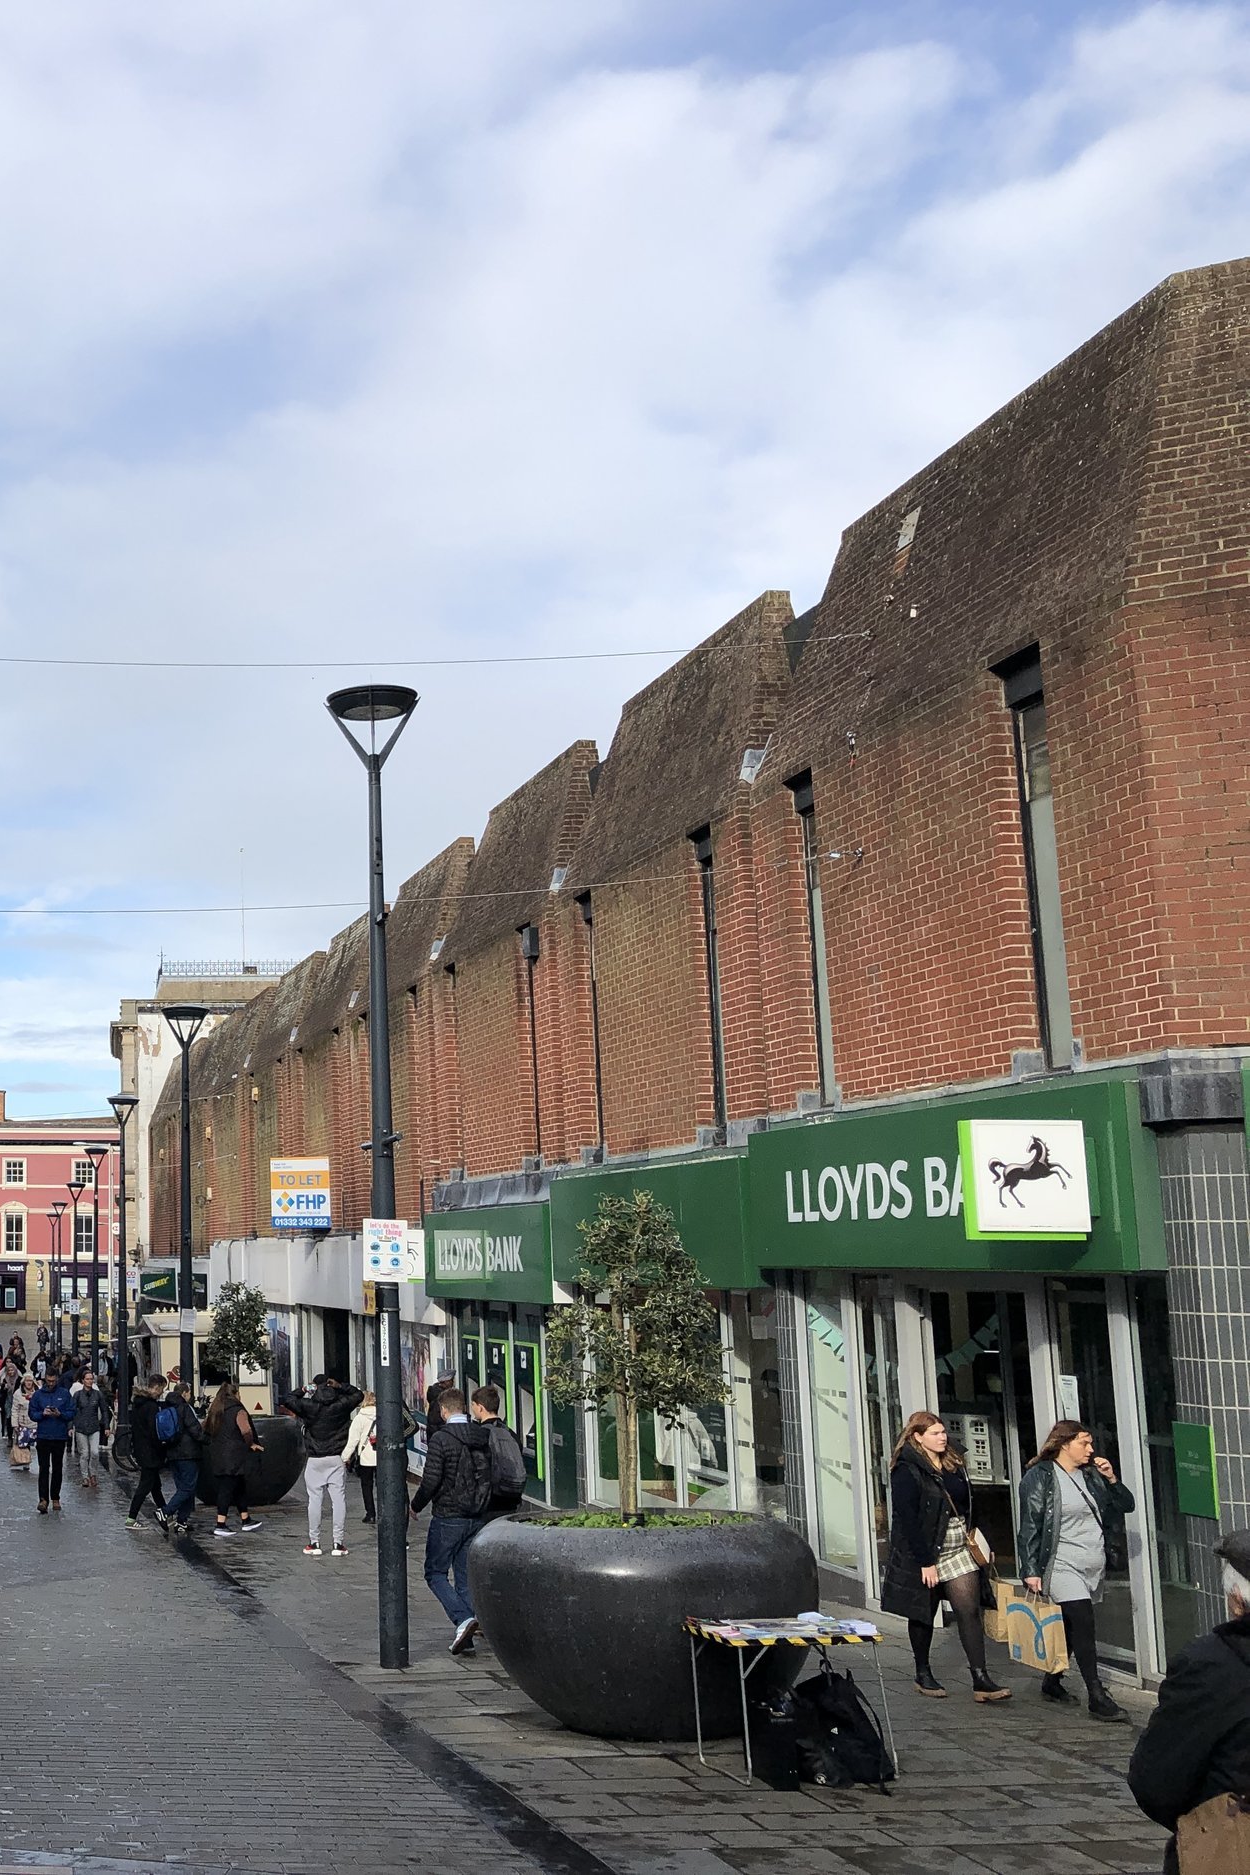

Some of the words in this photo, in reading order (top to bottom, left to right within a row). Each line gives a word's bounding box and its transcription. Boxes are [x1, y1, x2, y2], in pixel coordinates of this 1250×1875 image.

[279, 1175, 295, 1185] TO
[299, 1175, 322, 1185] LET
[785, 1159, 913, 1223] LLOYDS
[923, 1155, 964, 1218] BA
[296, 1194, 326, 1210] FHP
[275, 1218, 298, 1226] 01332
[298, 1218, 313, 1226] 343
[314, 1218, 328, 1226] 222
[386, 1229, 402, 1237] thing
[439, 1237, 483, 1272] LLOYDS
[486, 1235, 524, 1272] BANK
